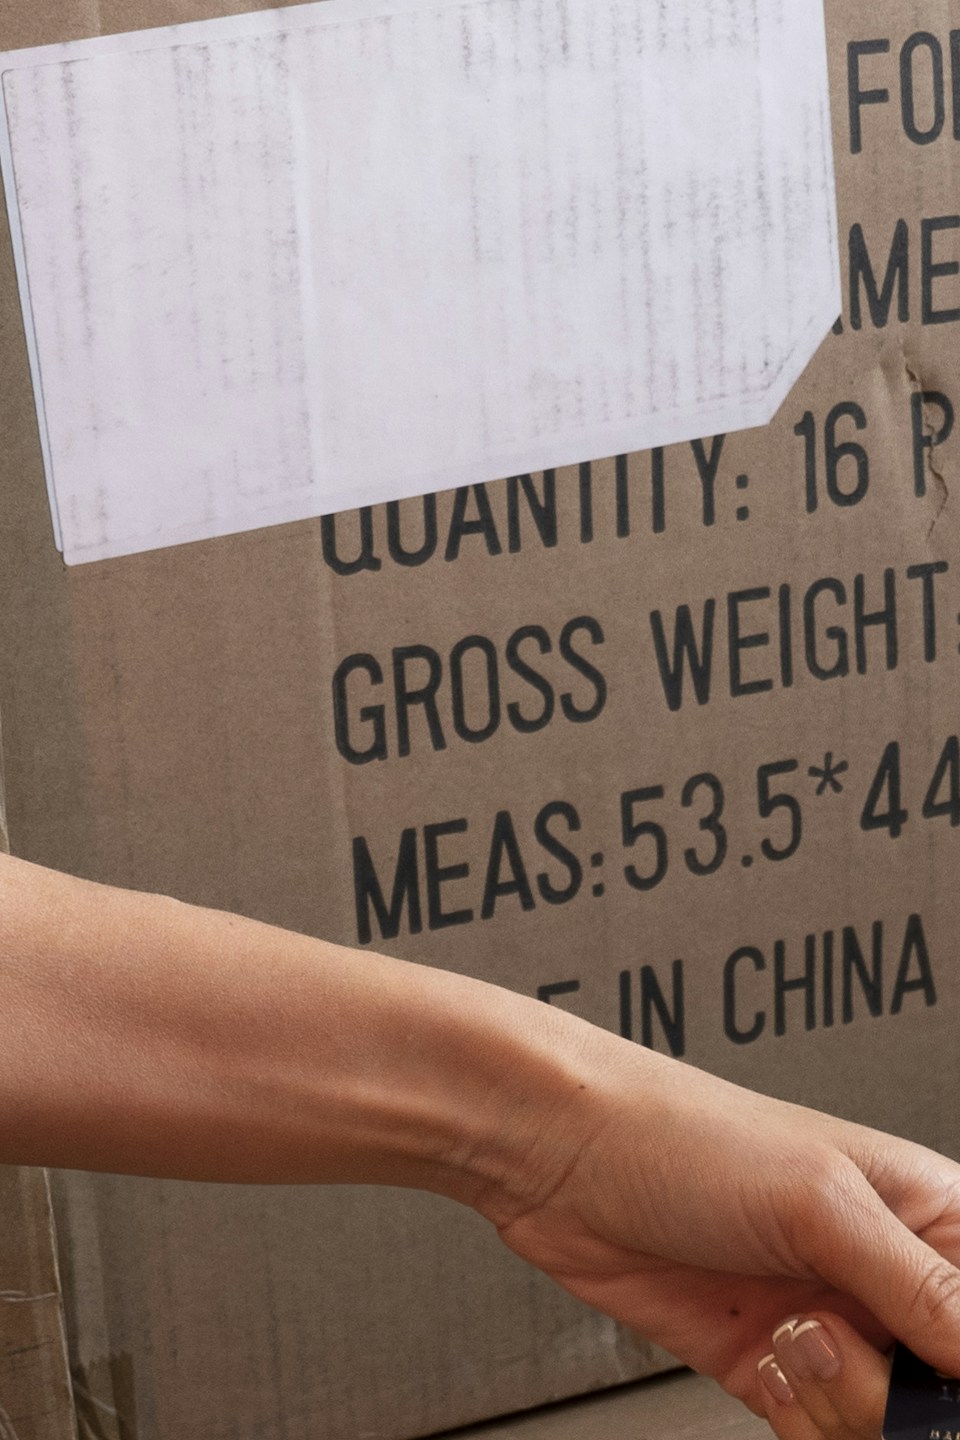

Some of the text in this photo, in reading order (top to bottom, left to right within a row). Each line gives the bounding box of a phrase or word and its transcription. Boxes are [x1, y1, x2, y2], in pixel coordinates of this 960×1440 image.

[794, 402, 870, 513] 16
[332, 615, 607, 765] GROSS
[619, 913, 937, 1058] IN CHINA
